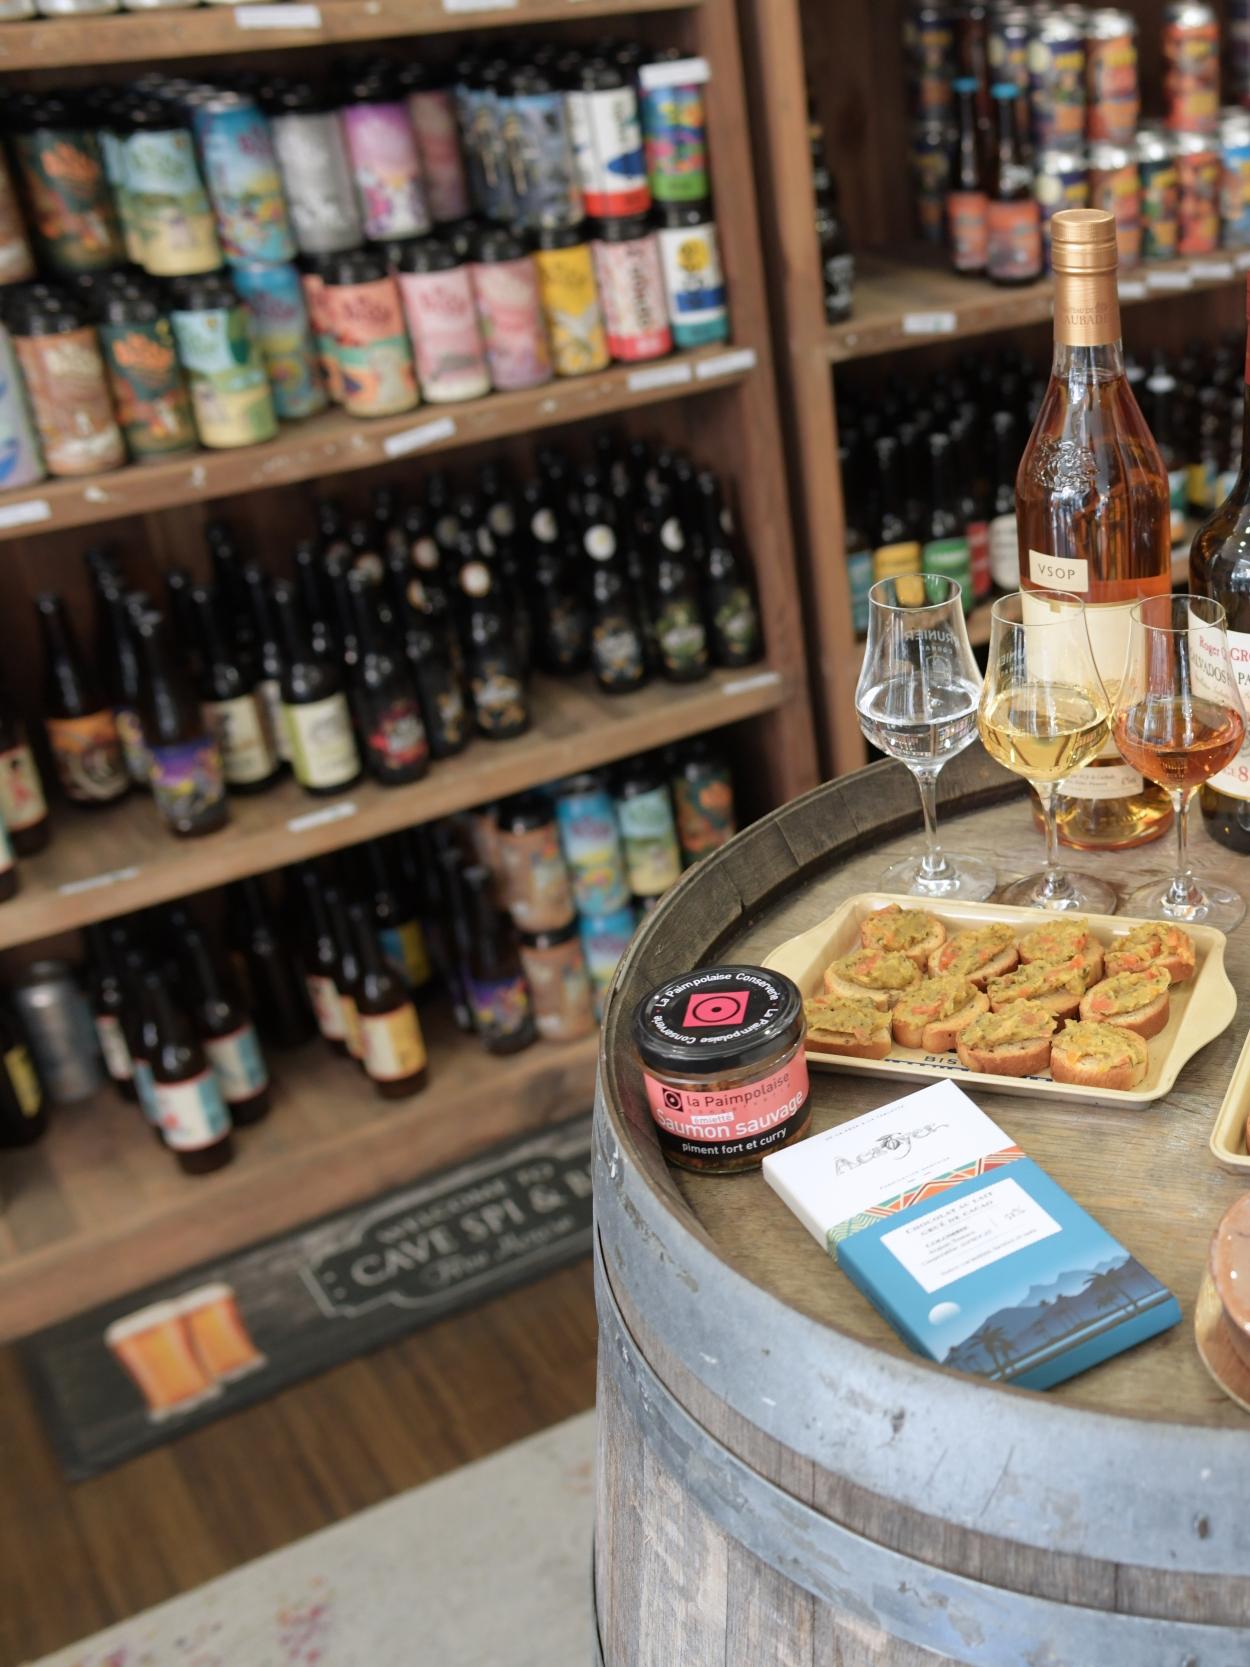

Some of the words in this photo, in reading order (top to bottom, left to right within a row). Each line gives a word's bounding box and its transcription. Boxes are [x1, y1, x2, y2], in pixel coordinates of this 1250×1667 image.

[1038, 563, 1076, 580] VSOP
[1238, 766, 1249, 782] 8
[655, 994, 670, 1008] La
[666, 972, 732, 998] Paimpolaise
[764, 1008, 779, 1018] La
[924, 1055, 959, 1065] BIS
[687, 1095, 700, 1107] la
[704, 1072, 790, 1107] Paimpolaise
[656, 1108, 730, 1138] Saumon
[736, 1090, 803, 1136] sauvage
[682, 1142, 719, 1155] piment
[721, 1143, 743, 1154] fort
[746, 1139, 757, 1150] et
[760, 1127, 787, 1146] curry
[350, 1223, 452, 1287] CAVE
[459, 1196, 526, 1243] SPI
[528, 1184, 567, 1215] &
